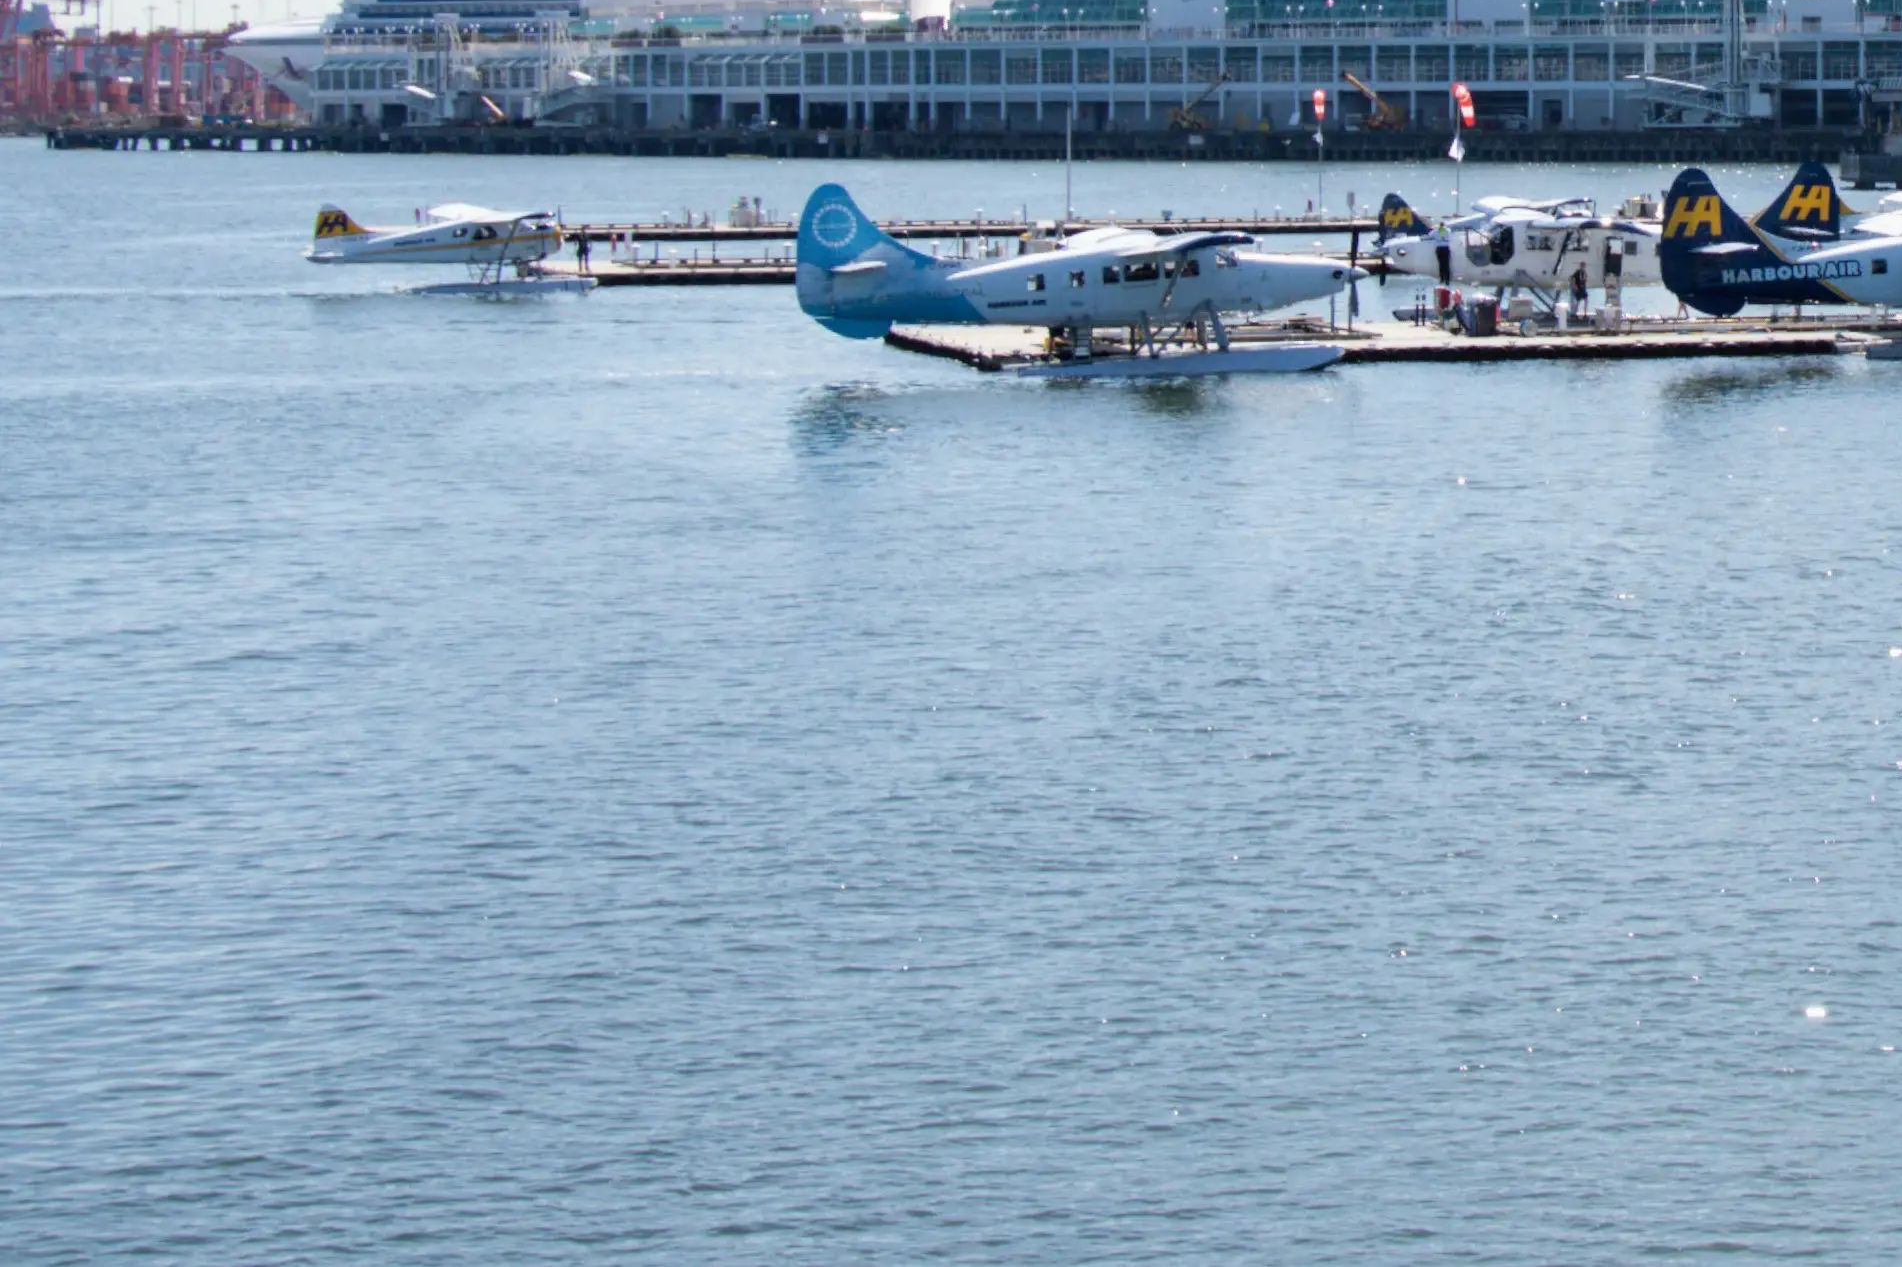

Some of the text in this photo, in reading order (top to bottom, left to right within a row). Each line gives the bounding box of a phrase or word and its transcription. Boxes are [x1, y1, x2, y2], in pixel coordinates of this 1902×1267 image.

[1662, 195, 1723, 239] HA
[1778, 183, 1832, 223] HA
[1721, 259, 1862, 284] HARBOUR AIR
